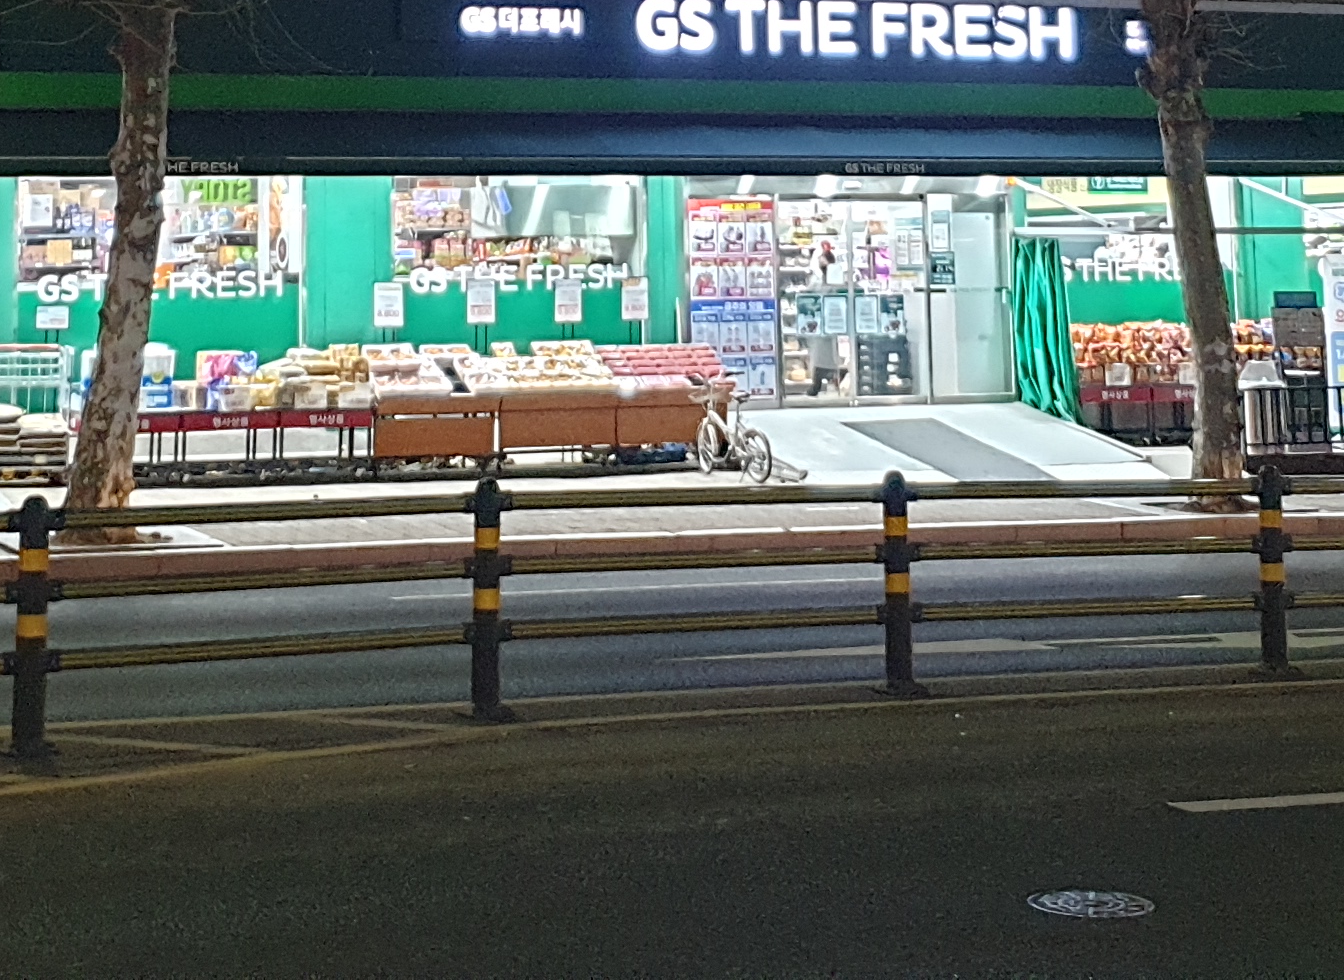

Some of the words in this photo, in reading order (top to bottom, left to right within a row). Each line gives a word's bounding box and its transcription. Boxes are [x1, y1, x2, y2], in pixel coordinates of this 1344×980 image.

[871, 1, 1078, 62] FRESH
[167, 161, 187, 173] HE
[191, 161, 239, 173] FRESH
[409, 266, 449, 294] GS
[1075, 257, 1131, 282] THE
[37, 273, 80, 302] GS
[168, 271, 284, 299] FRESH
